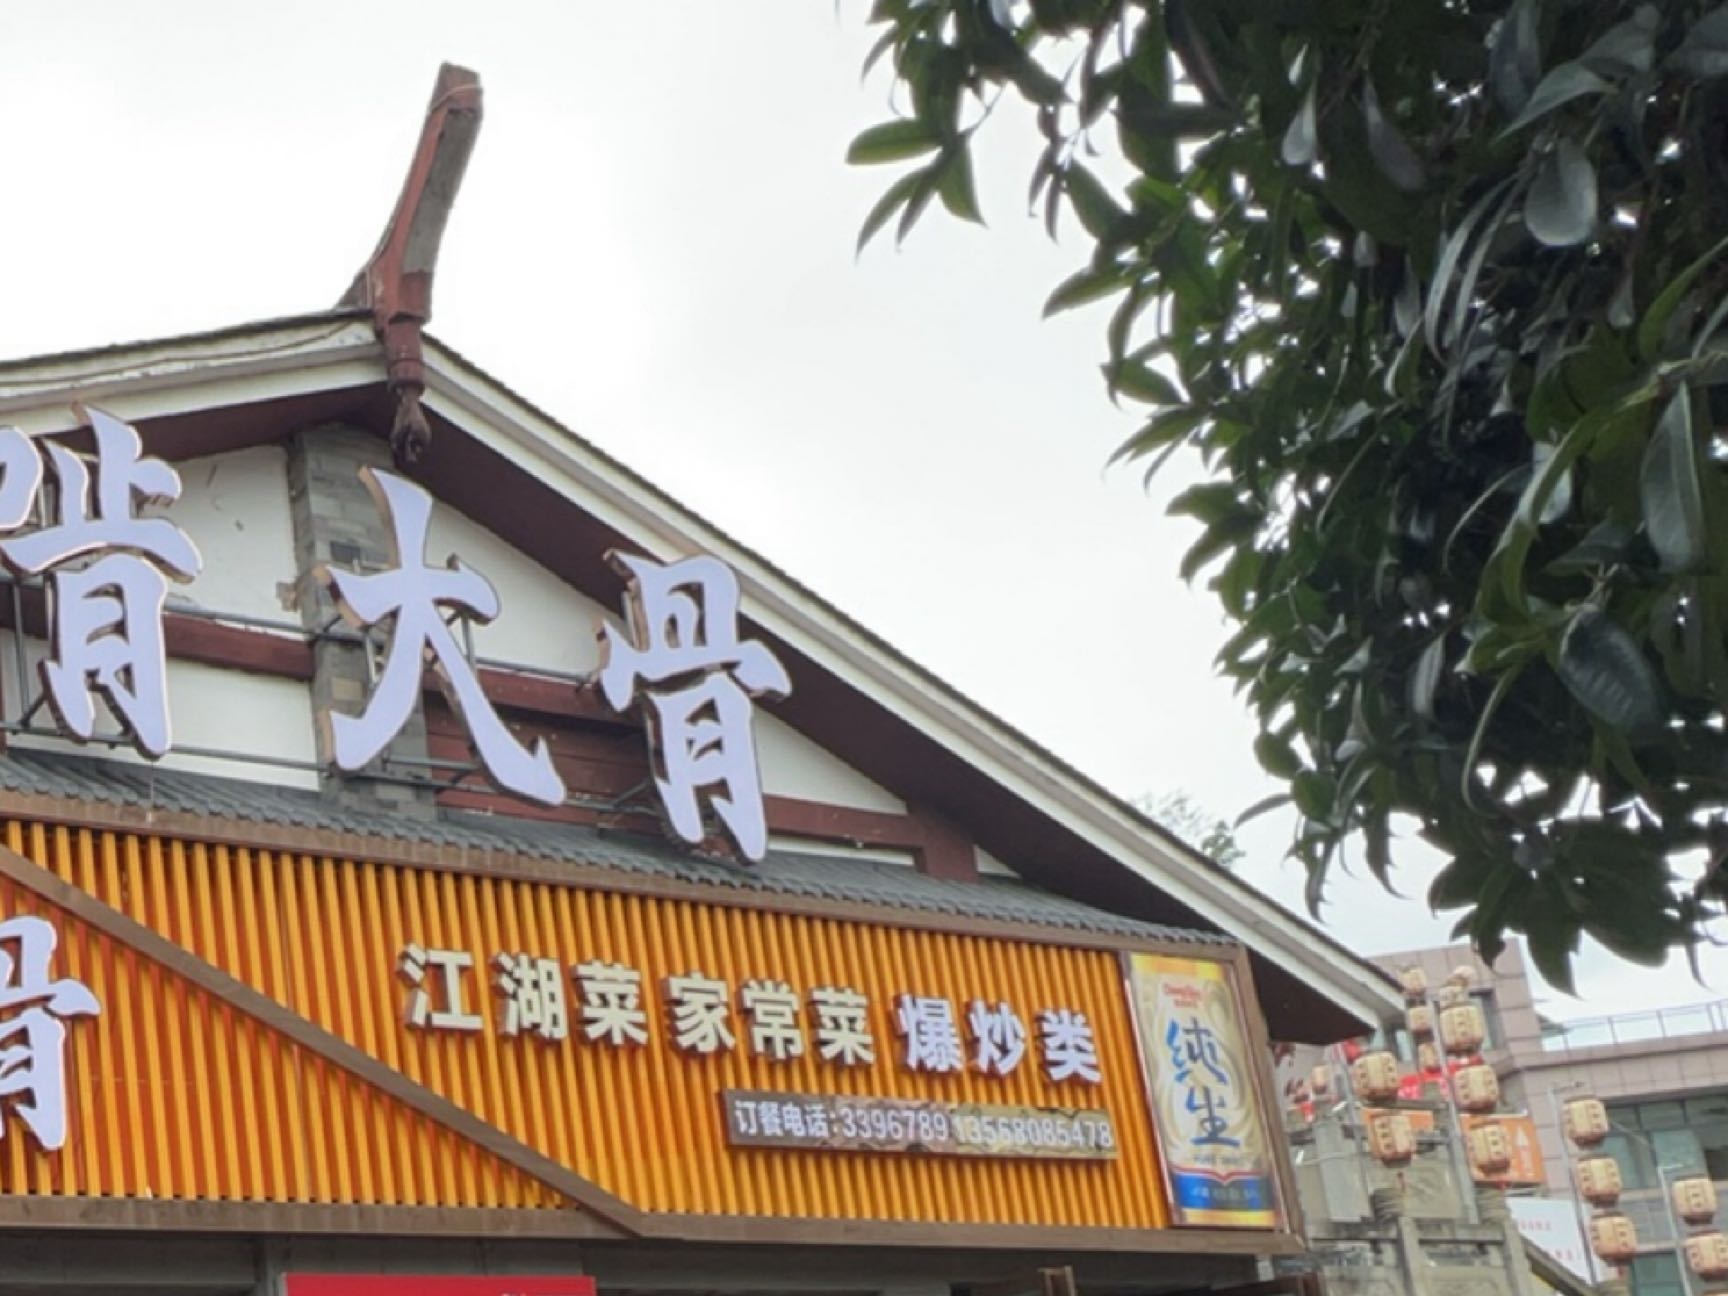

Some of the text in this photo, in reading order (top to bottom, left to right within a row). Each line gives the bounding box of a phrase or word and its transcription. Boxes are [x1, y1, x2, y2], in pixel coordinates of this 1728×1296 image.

[397, 942, 1104, 1087] 江湖菜 家常菜 爆炒类
